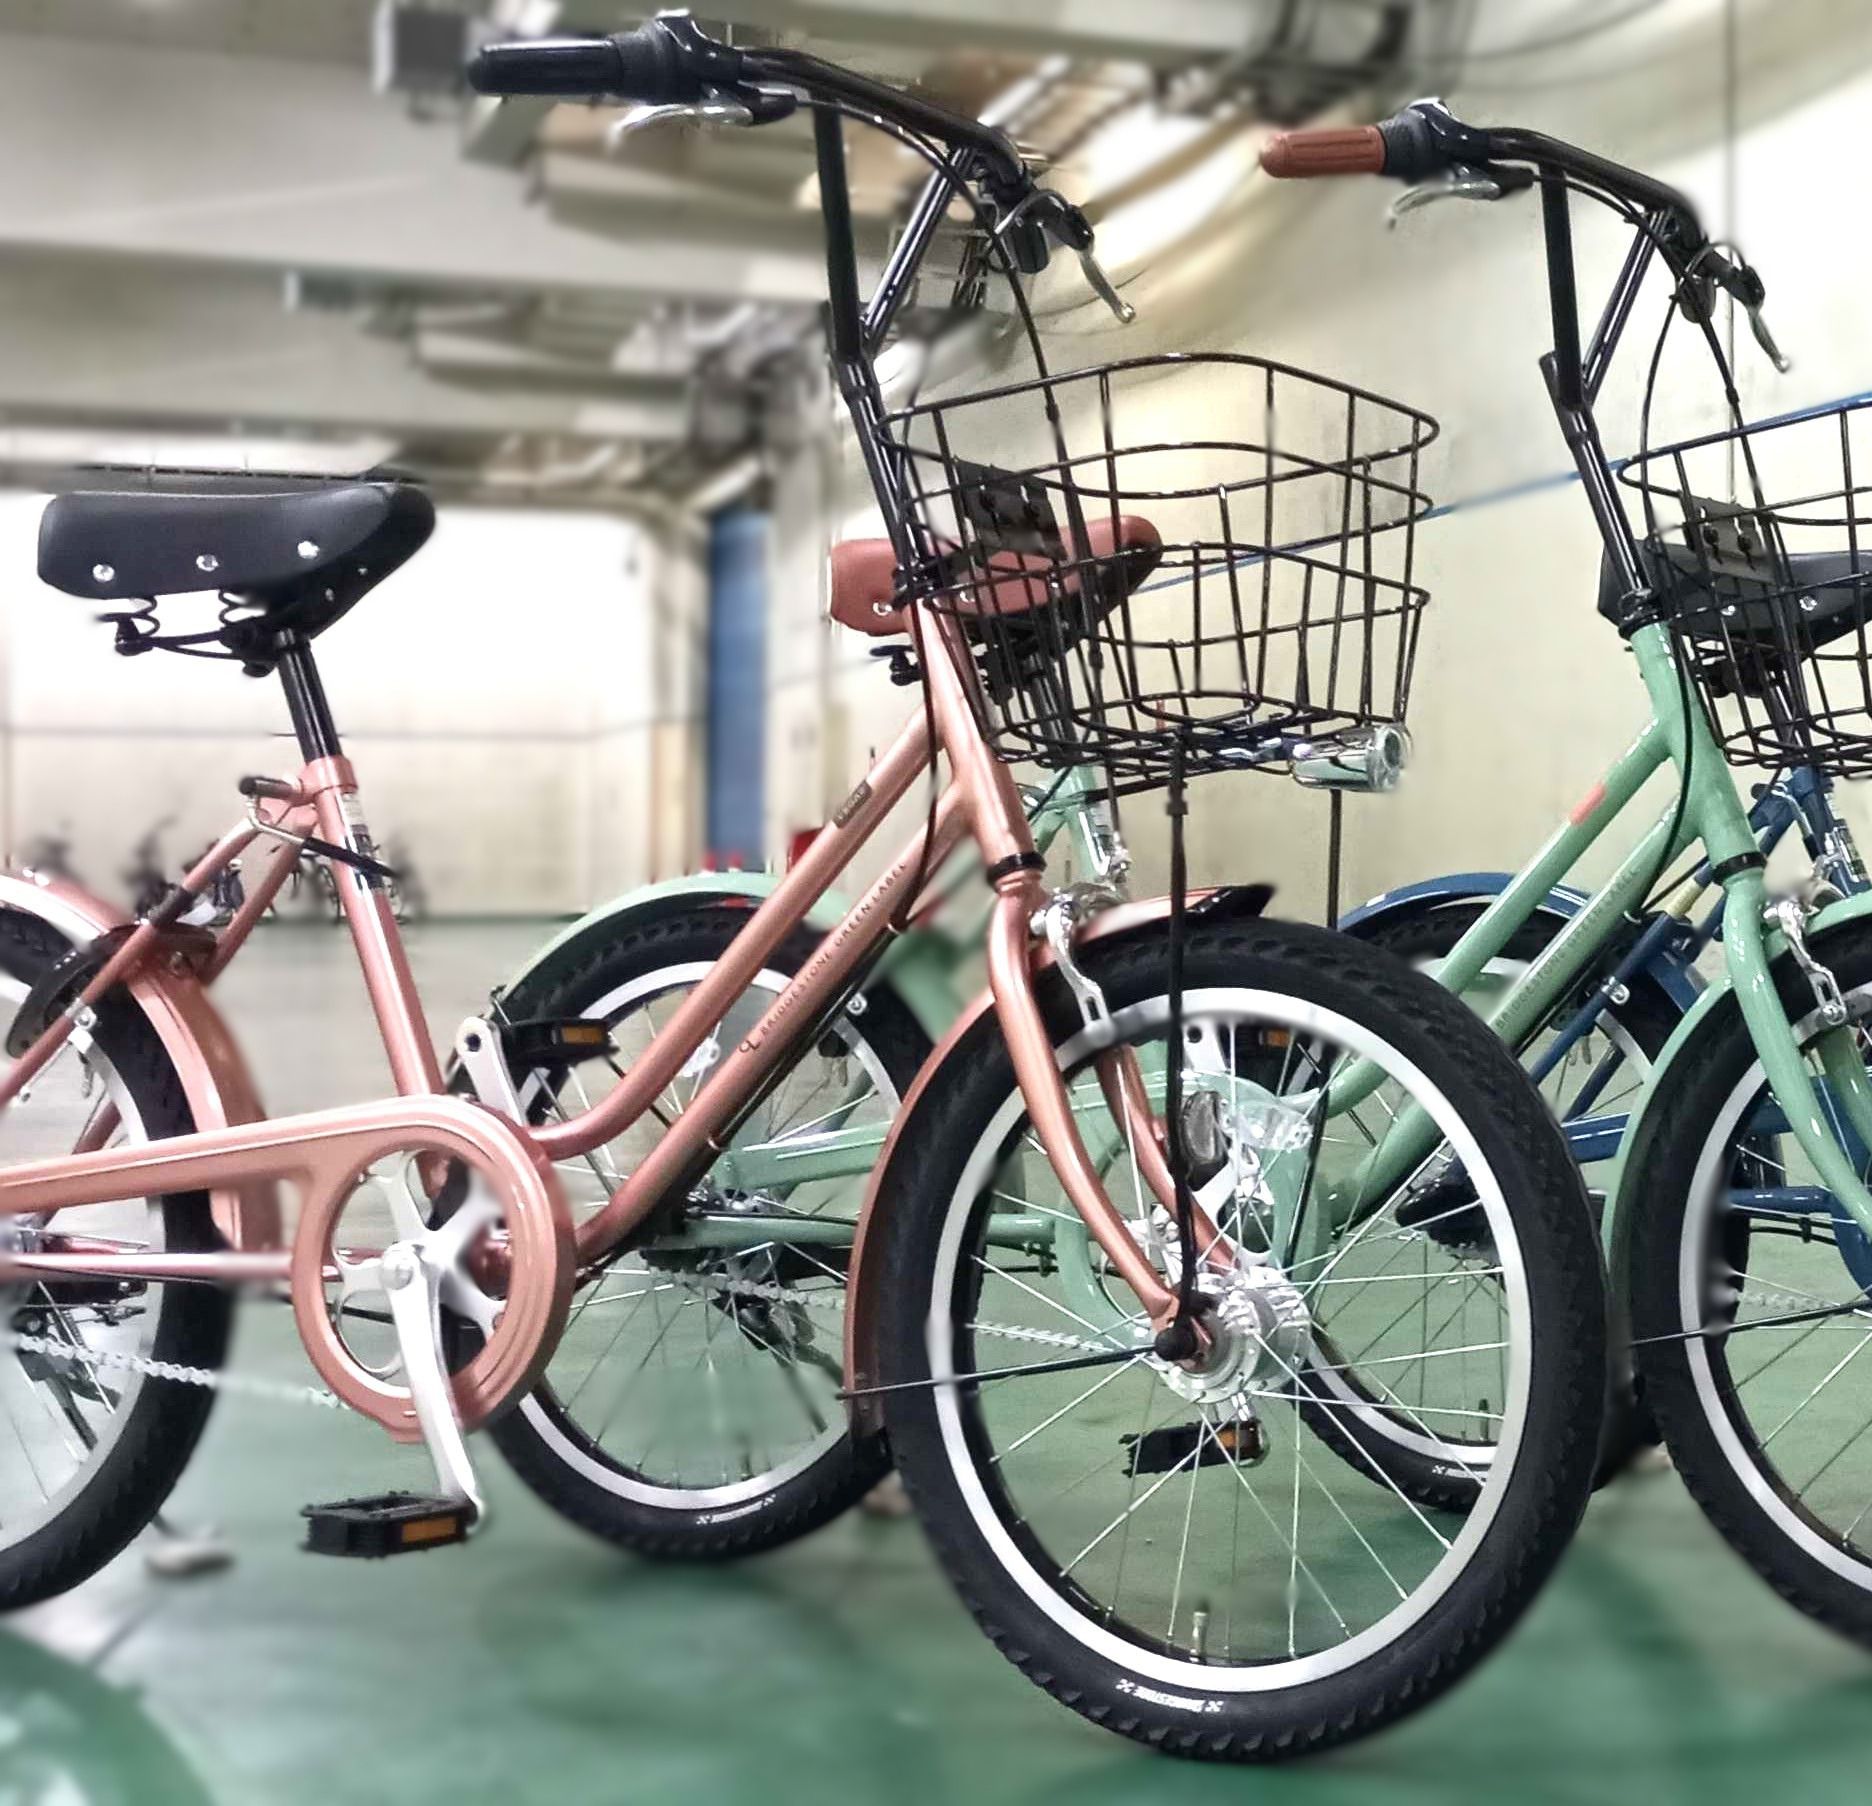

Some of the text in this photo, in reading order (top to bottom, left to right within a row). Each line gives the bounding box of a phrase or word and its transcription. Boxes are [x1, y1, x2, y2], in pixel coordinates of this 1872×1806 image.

[761, 953, 832, 1034] BRIDGESTONE
[836, 903, 870, 946] GREEN
[872, 863, 906, 901] LABEL
